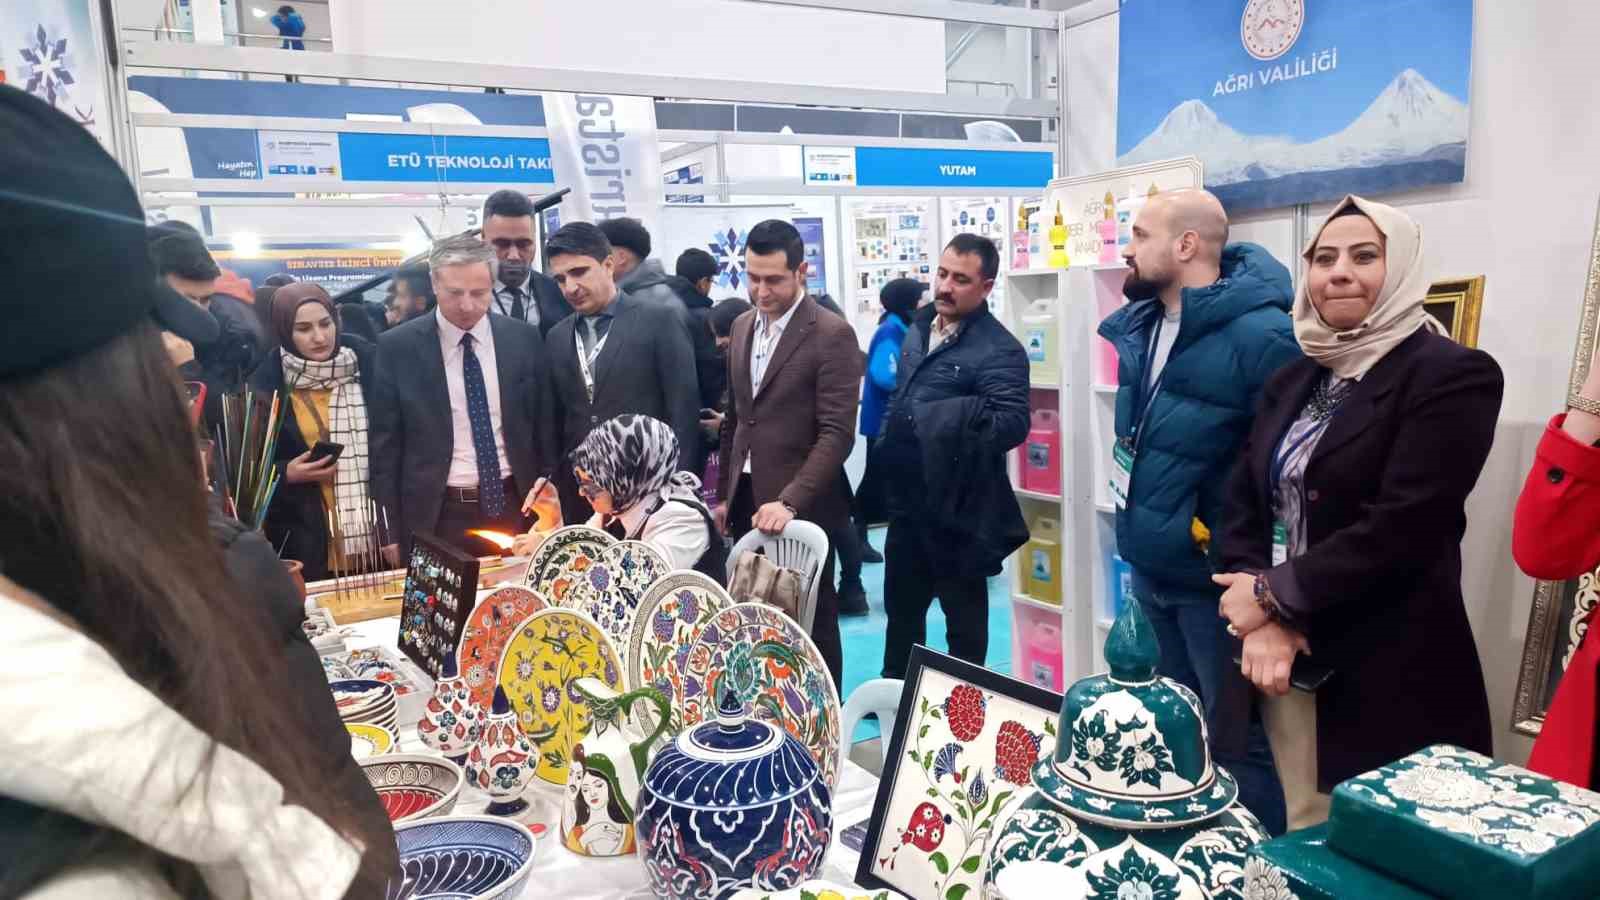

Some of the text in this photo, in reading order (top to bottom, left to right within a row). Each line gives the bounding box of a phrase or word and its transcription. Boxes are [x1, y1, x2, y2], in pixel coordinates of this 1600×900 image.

[1212, 46, 1337, 97] AĞRI VALİLİĞİ
[388, 152, 420, 167] ETÜ
[425, 154, 514, 169] TEKNOLOJİ
[939, 164, 976, 177] YUTAM
